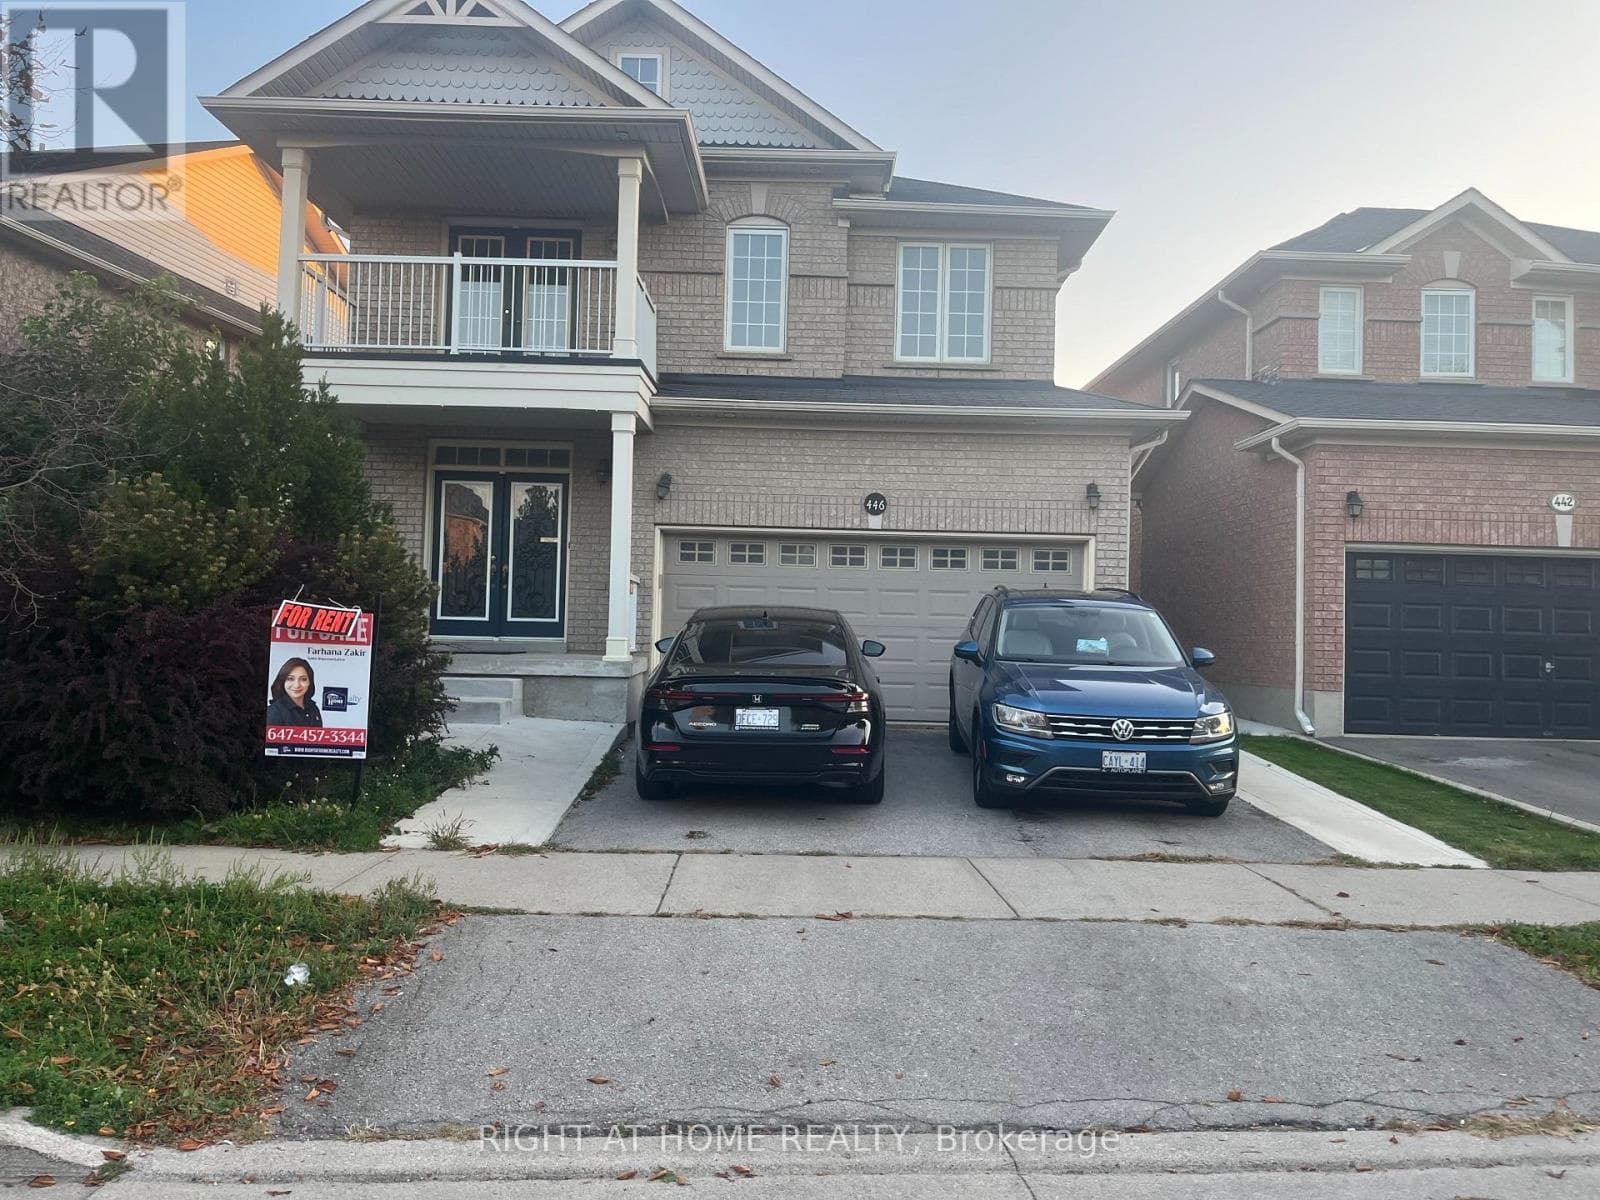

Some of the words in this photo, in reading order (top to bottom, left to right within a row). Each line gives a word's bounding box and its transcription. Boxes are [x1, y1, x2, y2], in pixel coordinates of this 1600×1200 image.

[866, 499, 885, 511] 446
[1554, 496, 1573, 507] 442
[277, 603, 312, 628] FOR
[311, 609, 356, 633] RENT
[307, 647, 342, 656] Farhana
[344, 648, 366, 657] Zakir
[267, 727, 365, 743] 647-457-3344
[1103, 755, 1124, 767] CAYL
[1130, 756, 1145, 768] 414
